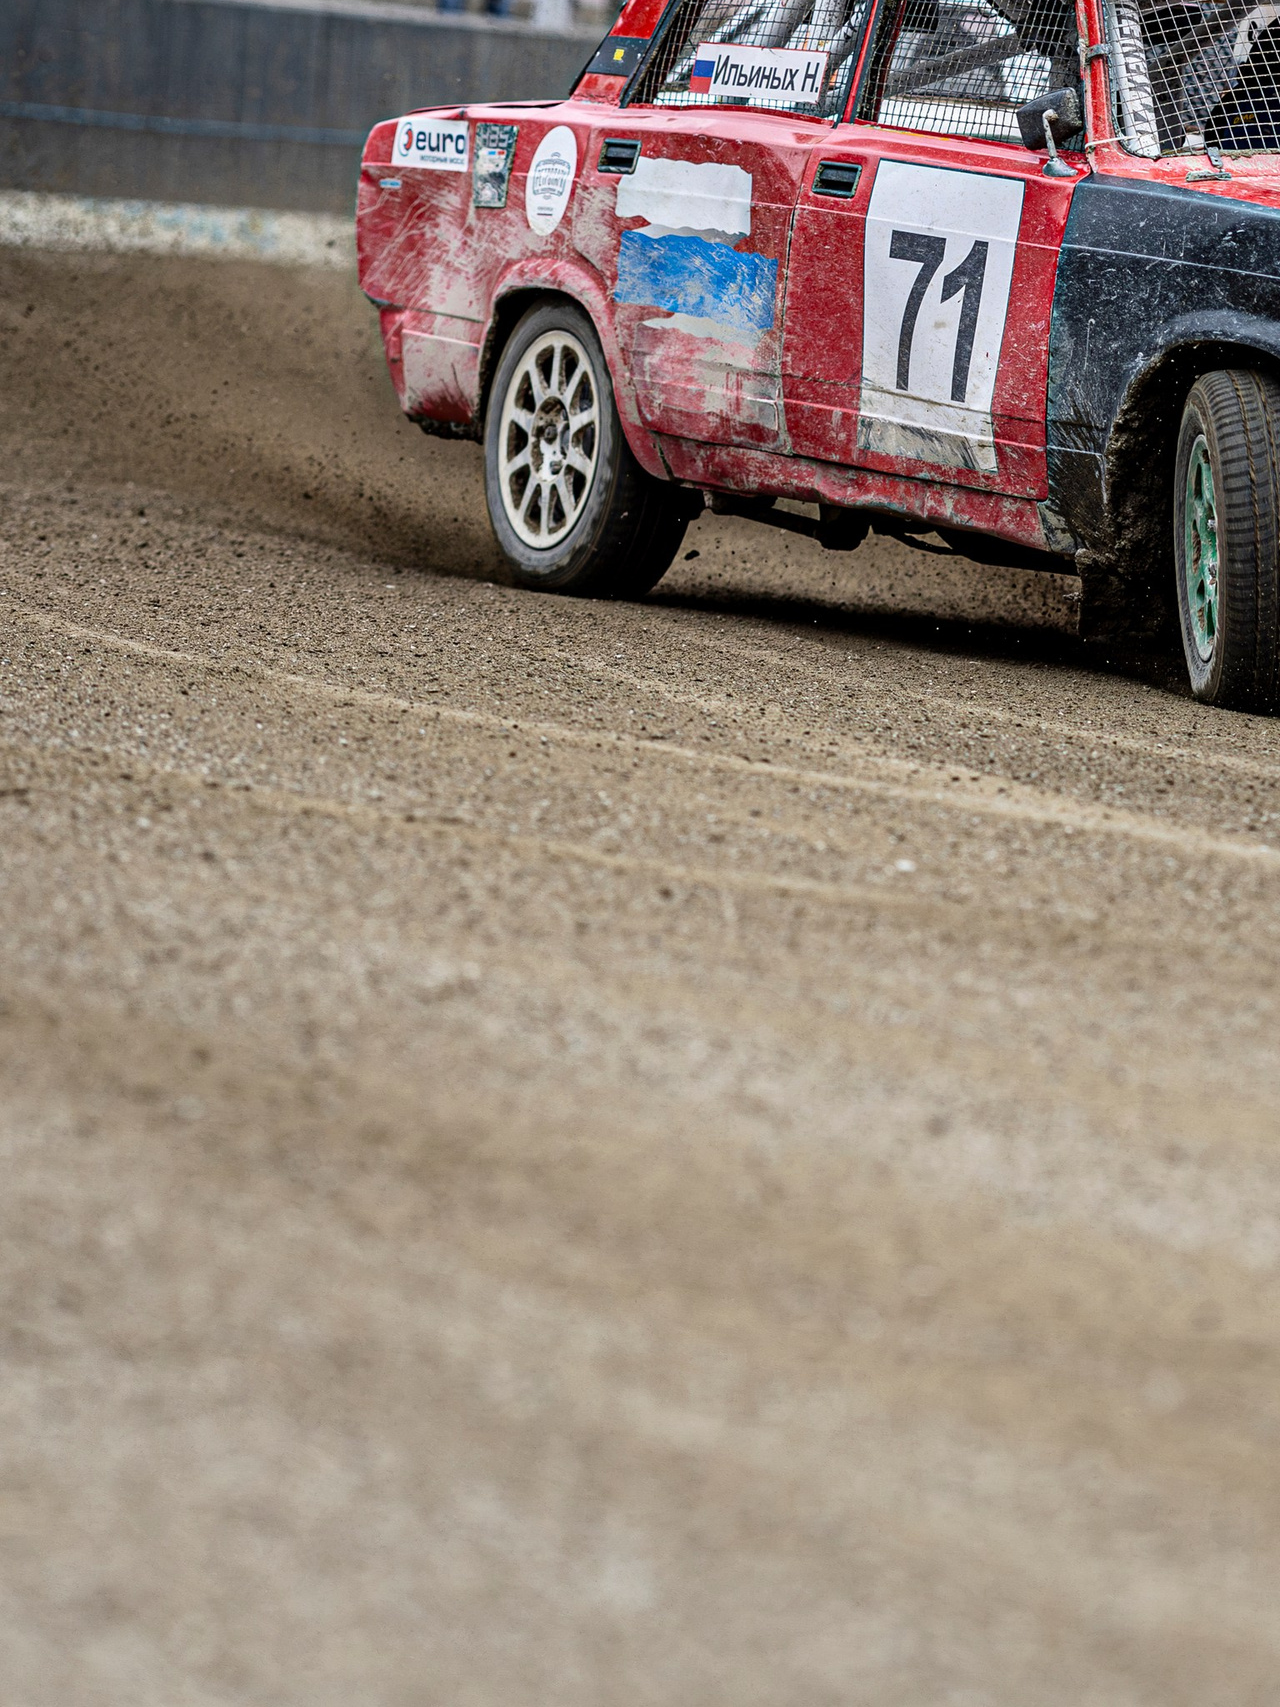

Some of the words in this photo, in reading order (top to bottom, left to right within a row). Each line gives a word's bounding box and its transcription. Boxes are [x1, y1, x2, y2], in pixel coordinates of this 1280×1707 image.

[713, 54, 799, 91] Ильиных
[801, 61, 820, 93] Н.
[888, 229, 989, 403] 71
